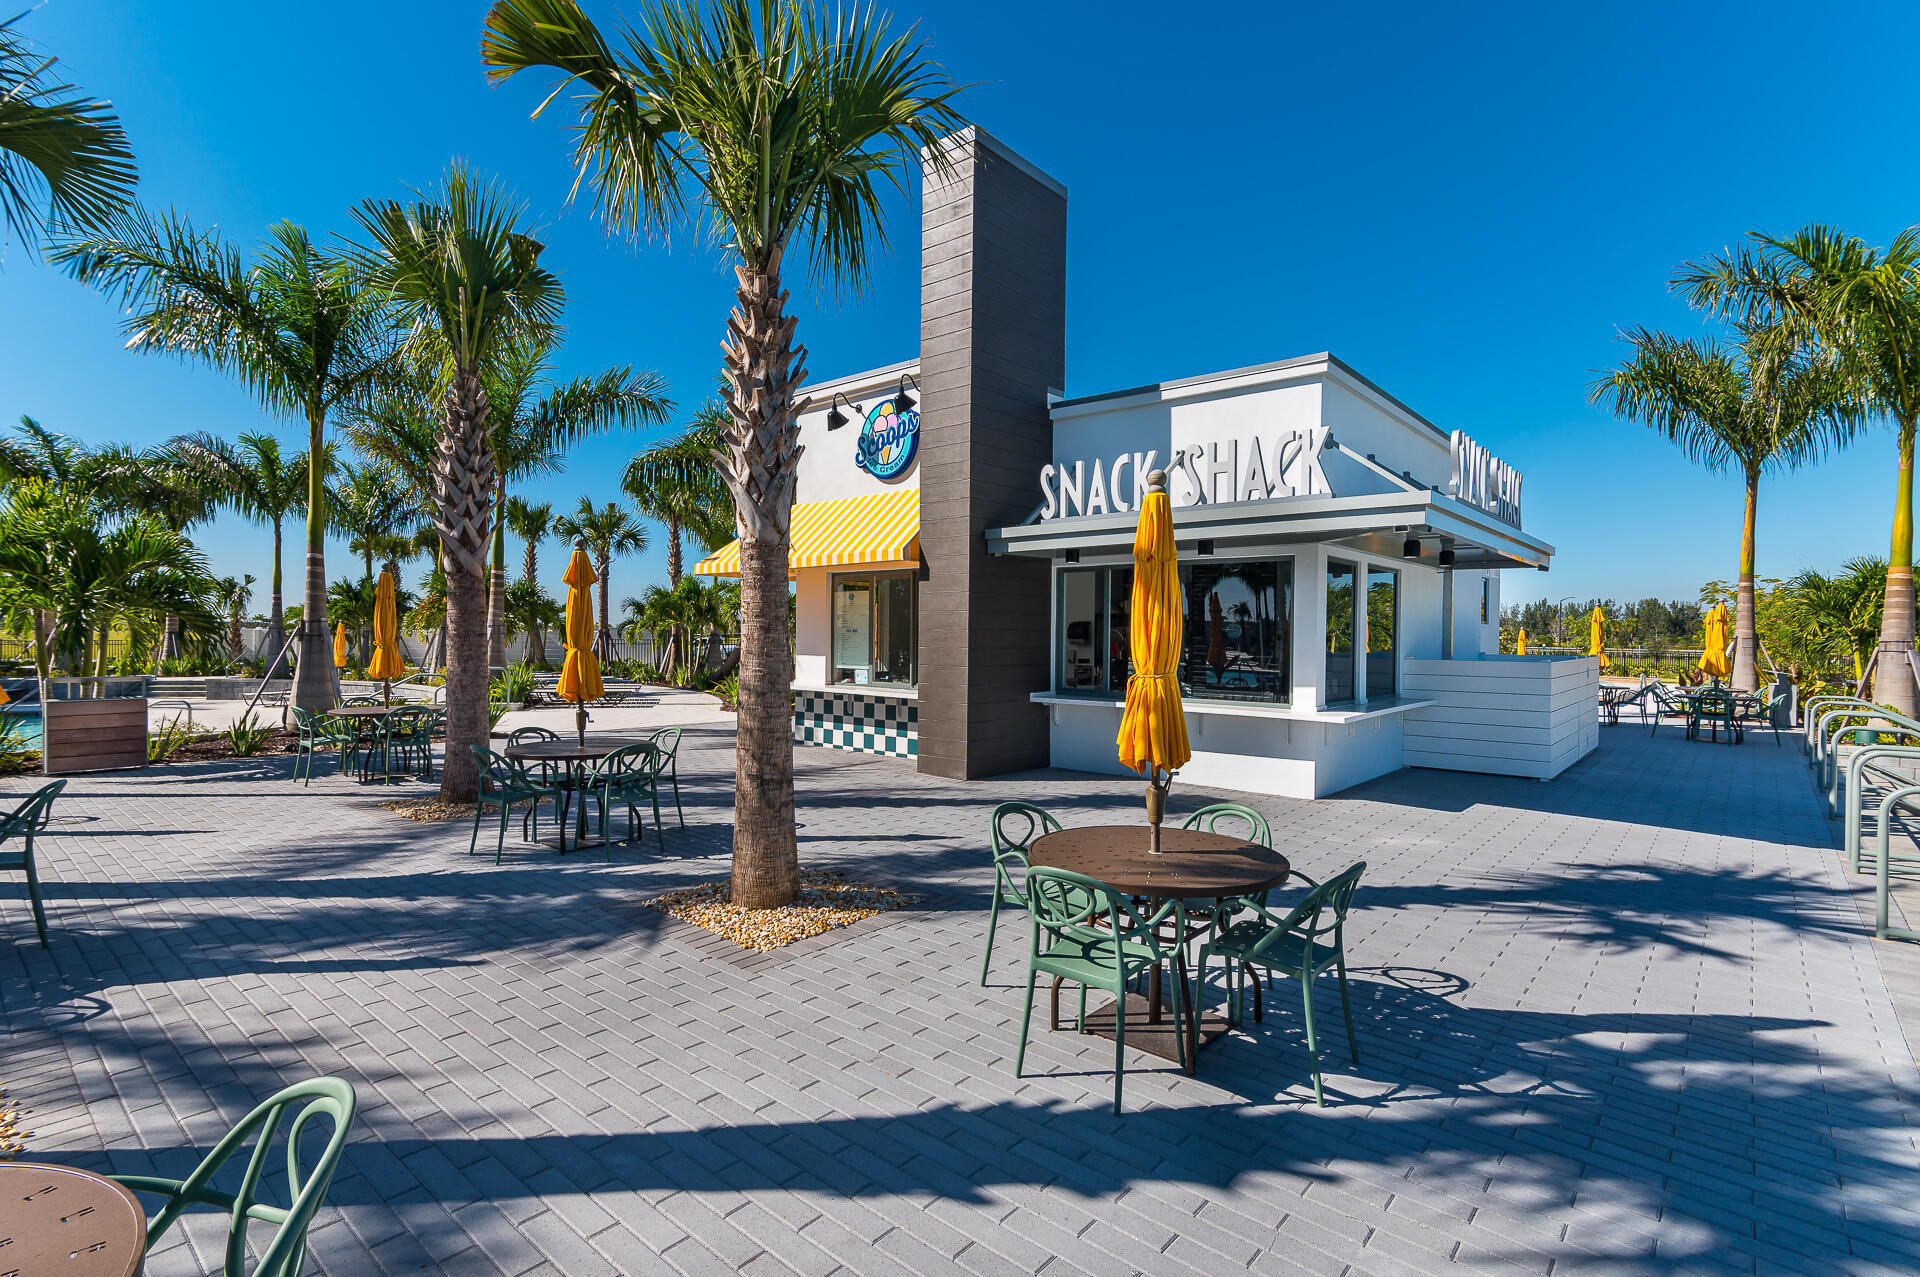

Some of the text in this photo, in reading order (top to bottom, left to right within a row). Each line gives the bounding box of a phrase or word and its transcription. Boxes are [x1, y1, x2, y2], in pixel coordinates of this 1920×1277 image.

[856, 413, 920, 465] Scoops
[879, 454, 906, 473] Cream
[1040, 426, 1334, 519] SNACK SHACK
